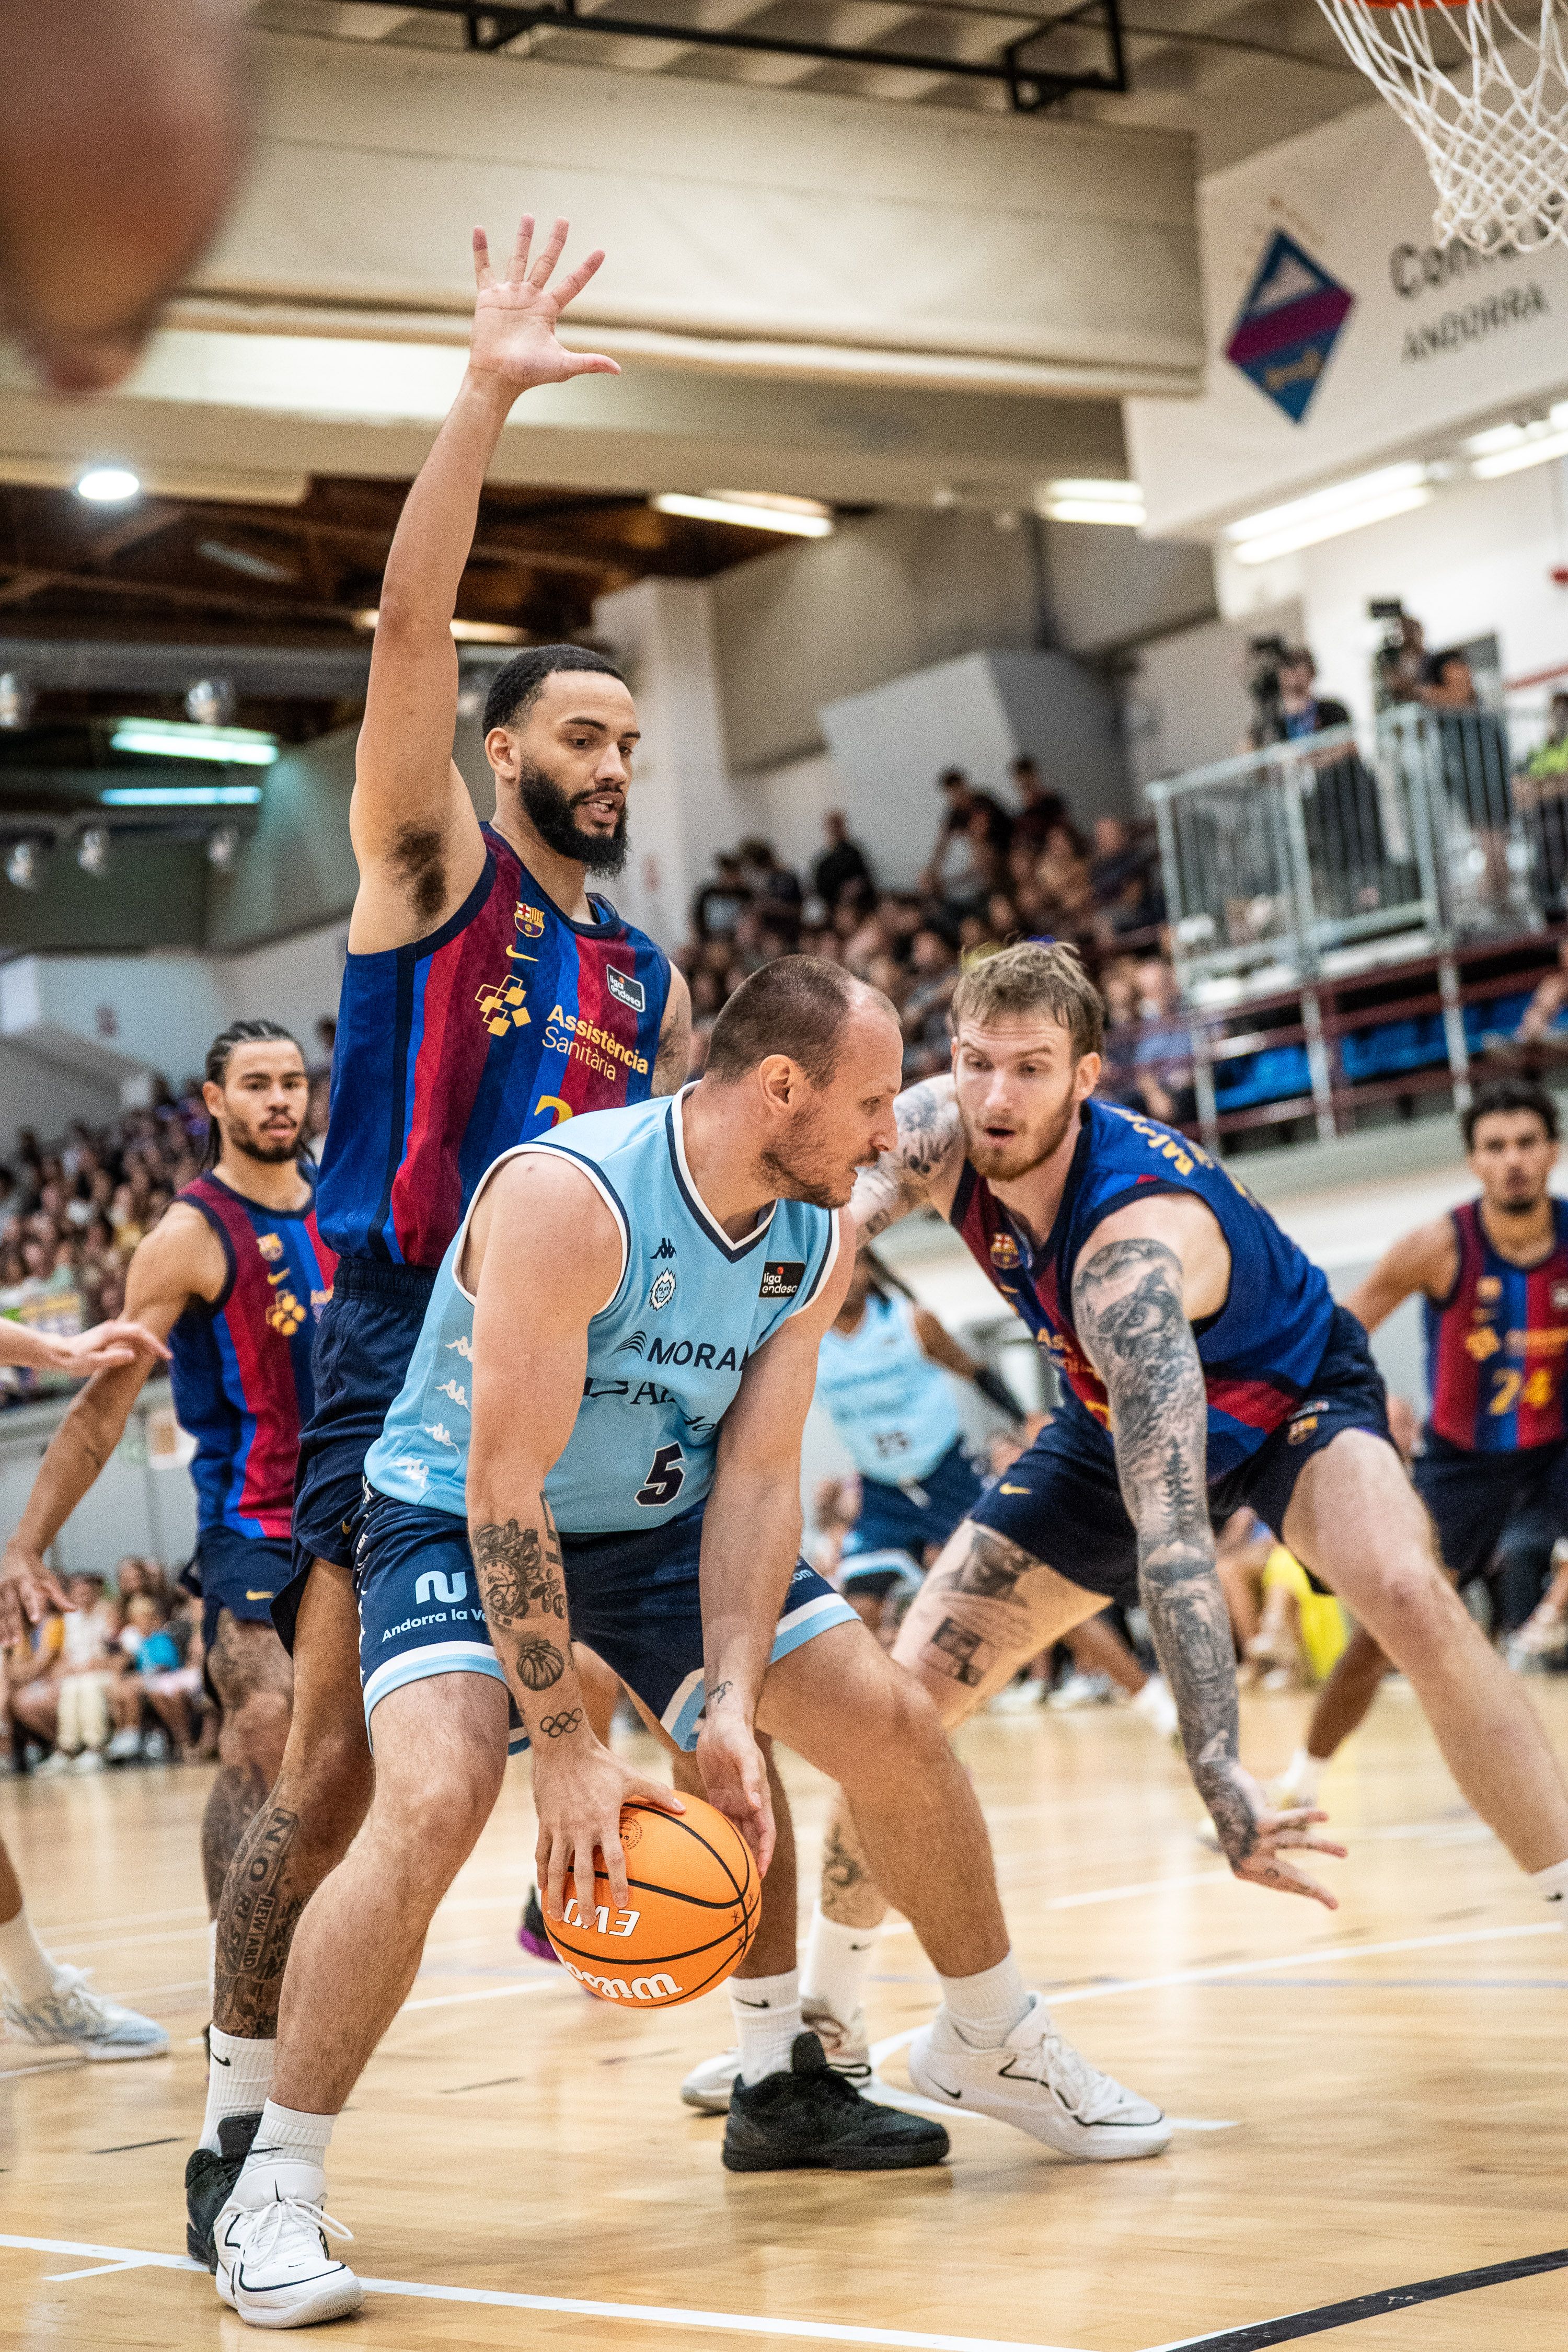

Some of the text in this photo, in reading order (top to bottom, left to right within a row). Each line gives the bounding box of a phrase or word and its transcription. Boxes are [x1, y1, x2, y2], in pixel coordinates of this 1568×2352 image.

[609, 975, 624, 989] liga
[610, 985, 641, 1007] endesa
[542, 1026, 616, 1081] Sanitària
[547, 1005, 648, 1075] Assistència
[762, 1284, 798, 1293] endesa
[764, 1272, 781, 1285] liga
[634, 1440, 685, 1506] 5
[382, 1612, 447, 1643] Andorra
[451, 1609, 467, 1620] la
[554, 1947, 683, 2000] Wilso
